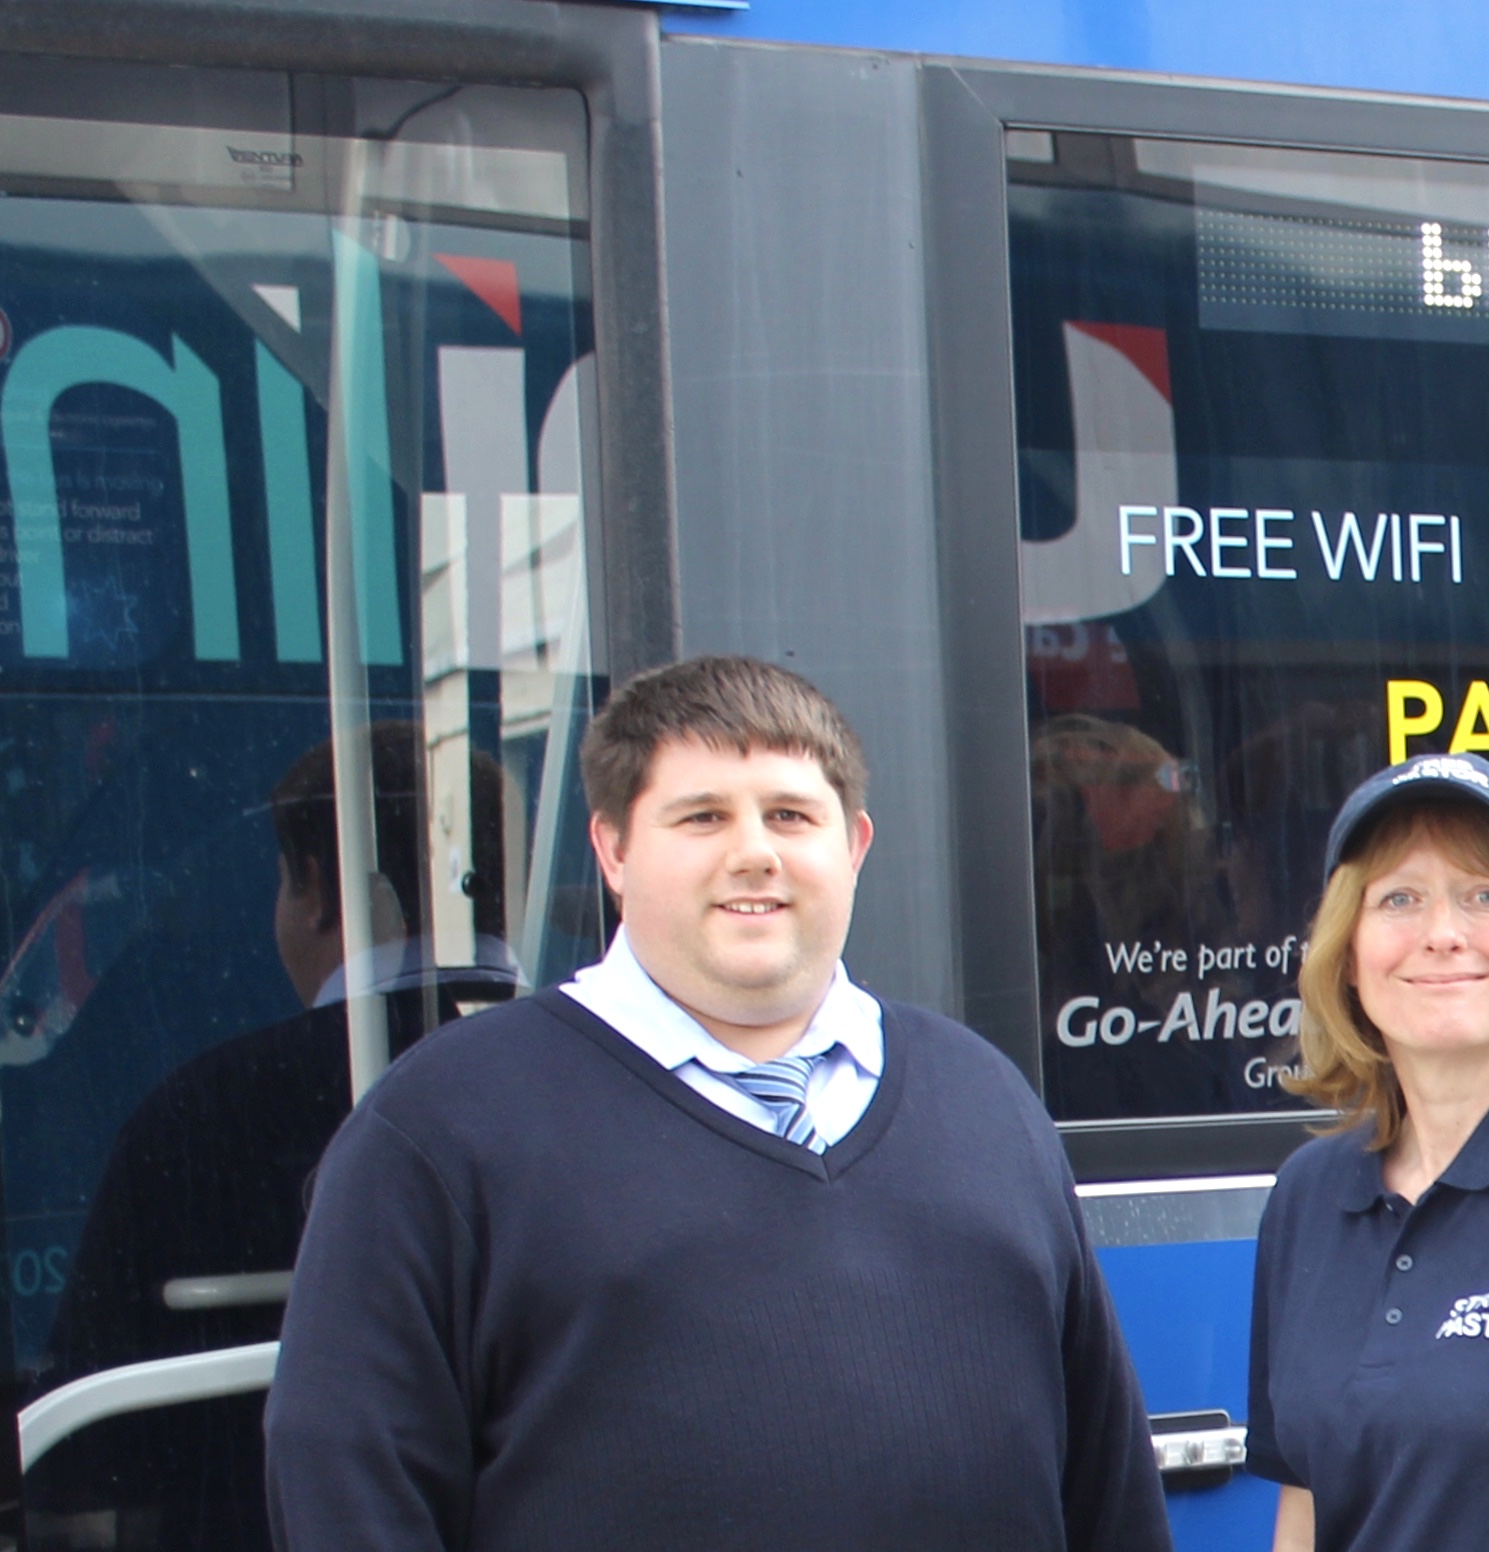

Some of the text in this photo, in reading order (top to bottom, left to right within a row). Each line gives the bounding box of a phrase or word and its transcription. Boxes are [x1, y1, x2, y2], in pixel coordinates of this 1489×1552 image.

[1118, 504, 1463, 584] FREE WIFI
[1104, 940, 1189, 974] We're
[1199, 942, 1257, 980] part
[1265, 935, 1297, 975] of
[1056, 987, 1303, 1048] Go-Ahea
